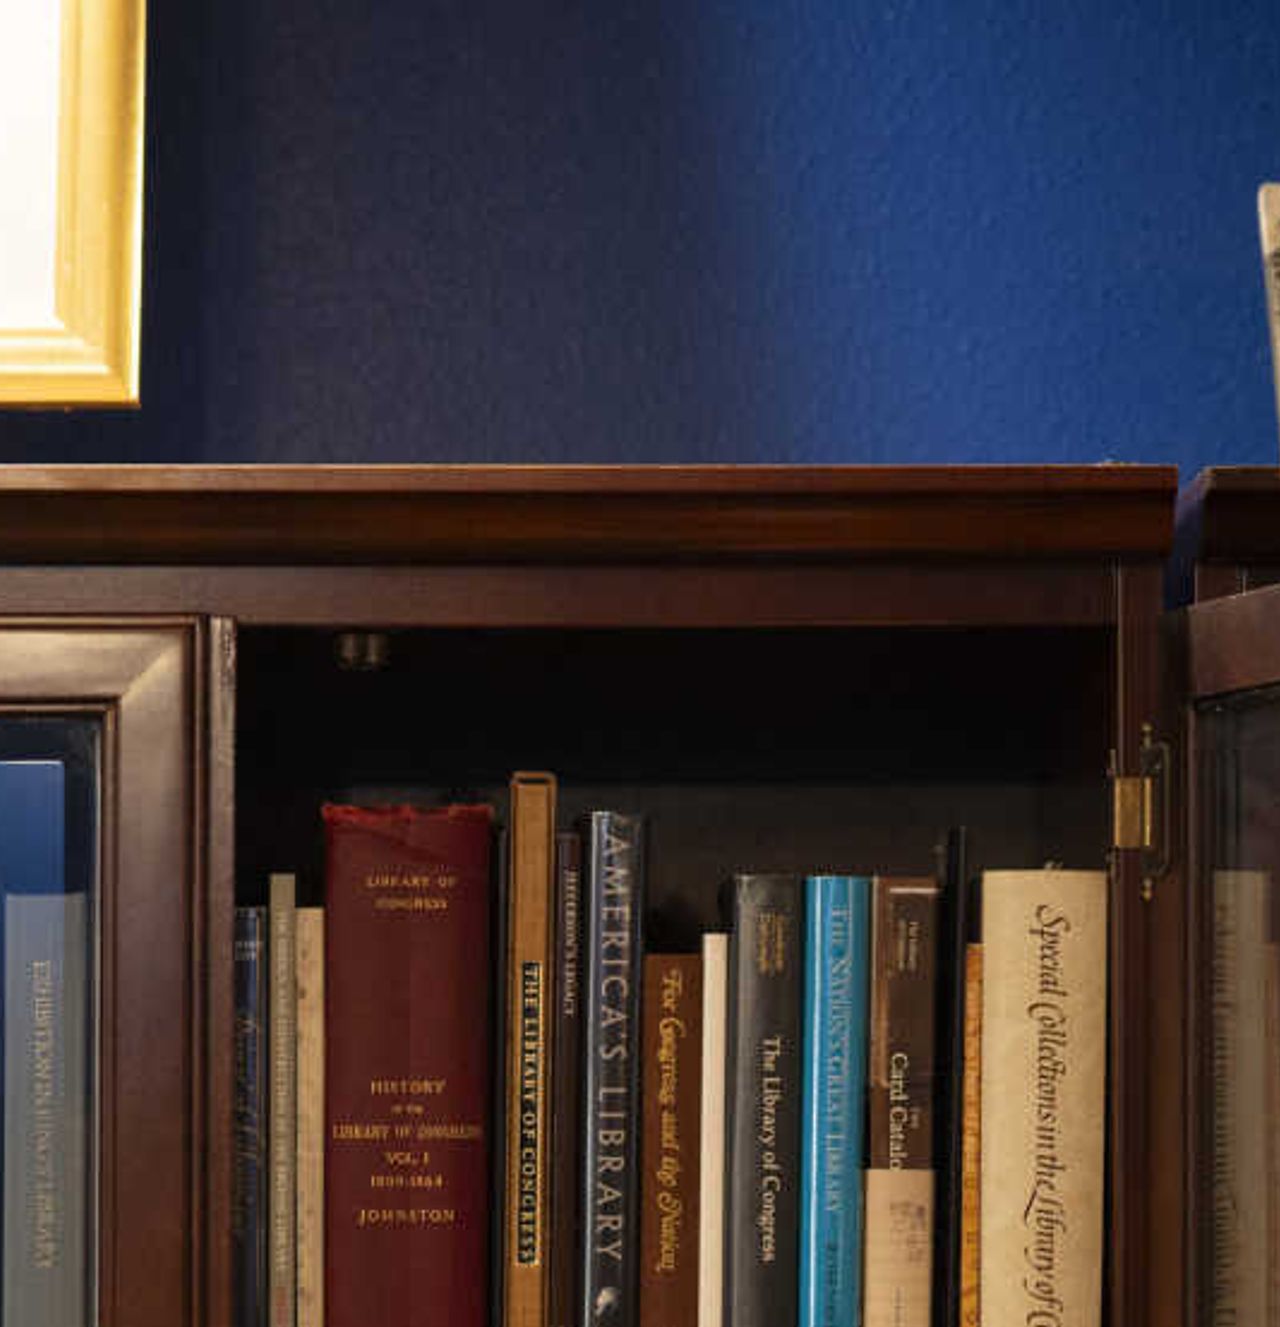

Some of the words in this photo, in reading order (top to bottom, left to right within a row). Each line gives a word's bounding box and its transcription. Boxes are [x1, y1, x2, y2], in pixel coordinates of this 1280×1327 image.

[365, 875, 430, 888] LIBRARY
[600, 835, 629, 1062] AMERICA'S
[1030, 904, 1072, 995] Special
[524, 967, 541, 1008] THE
[662, 969, 683, 1008] For
[523, 1018, 540, 1103] LIBRARY
[658, 1018, 686, 1103] Congress
[759, 1037, 782, 1073] The
[888, 1052, 909, 1101] Card
[1028, 1001, 1068, 1122] Collections
[371, 1079, 447, 1095] HISTORY
[758, 1076, 782, 1144] Library
[522, 1111, 538, 1141] OF
[662, 1112, 680, 1151] and
[888, 1106, 909, 1171] Catalo
[1034, 1123, 1063, 1149] in
[596, 1087, 625, 1262] LIBRARY
[759, 1151, 782, 1172] of
[824, 1133, 847, 1213] LIBRARY
[1034, 1152, 1064, 1188] the
[520, 1147, 538, 1260] CONGRESS
[758, 1175, 782, 1262] Congress
[1023, 1187, 1068, 1278] Library
[1025, 1278, 1067, 1308] of
